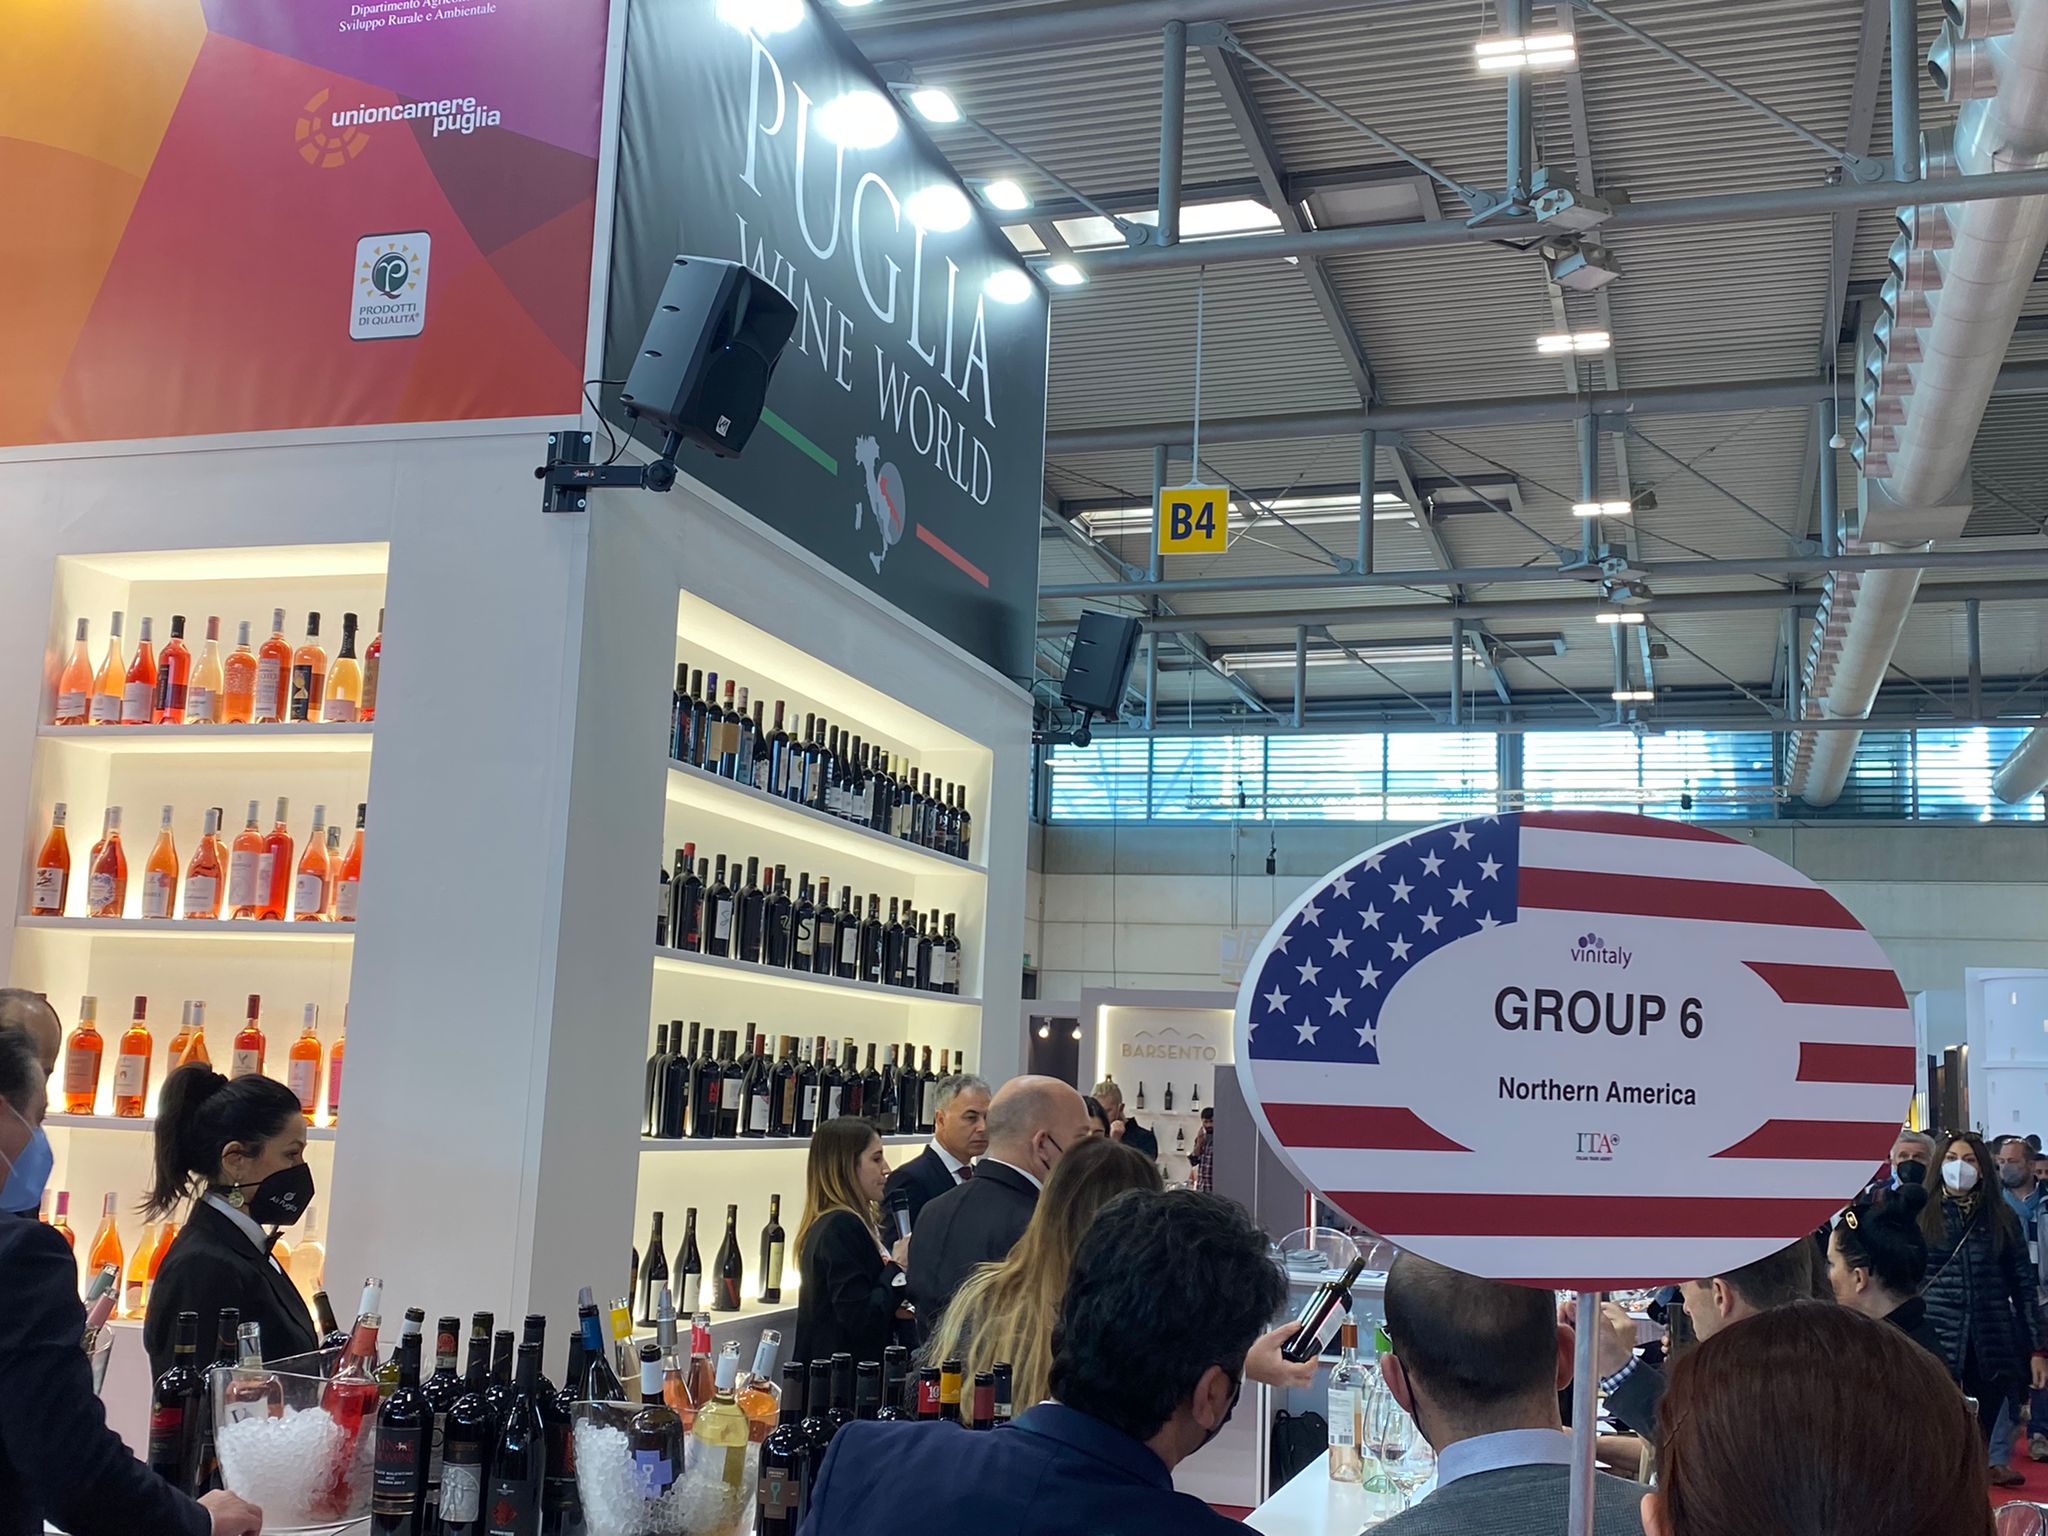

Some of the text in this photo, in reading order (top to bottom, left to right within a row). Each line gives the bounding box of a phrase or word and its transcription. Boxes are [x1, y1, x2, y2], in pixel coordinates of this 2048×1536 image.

[339, 3, 497, 32] Sviluppo Rurale e Ambientale
[351, 0, 420, 17] Dipartimento
[331, 97, 476, 127] unioncamere
[432, 105, 501, 137] puglia
[739, 28, 997, 429] PUGLIA
[358, 317, 370, 326] DI
[359, 303, 417, 315] PRODOTTI
[875, 344, 993, 505] WORLD
[1171, 502, 1216, 540] B4
[1571, 946, 1632, 969] vinitaly
[1494, 986, 1703, 1039] GROUP 6
[1122, 1043, 1217, 1061] BARSENTO
[1499, 1076, 1697, 1105] Northern America
